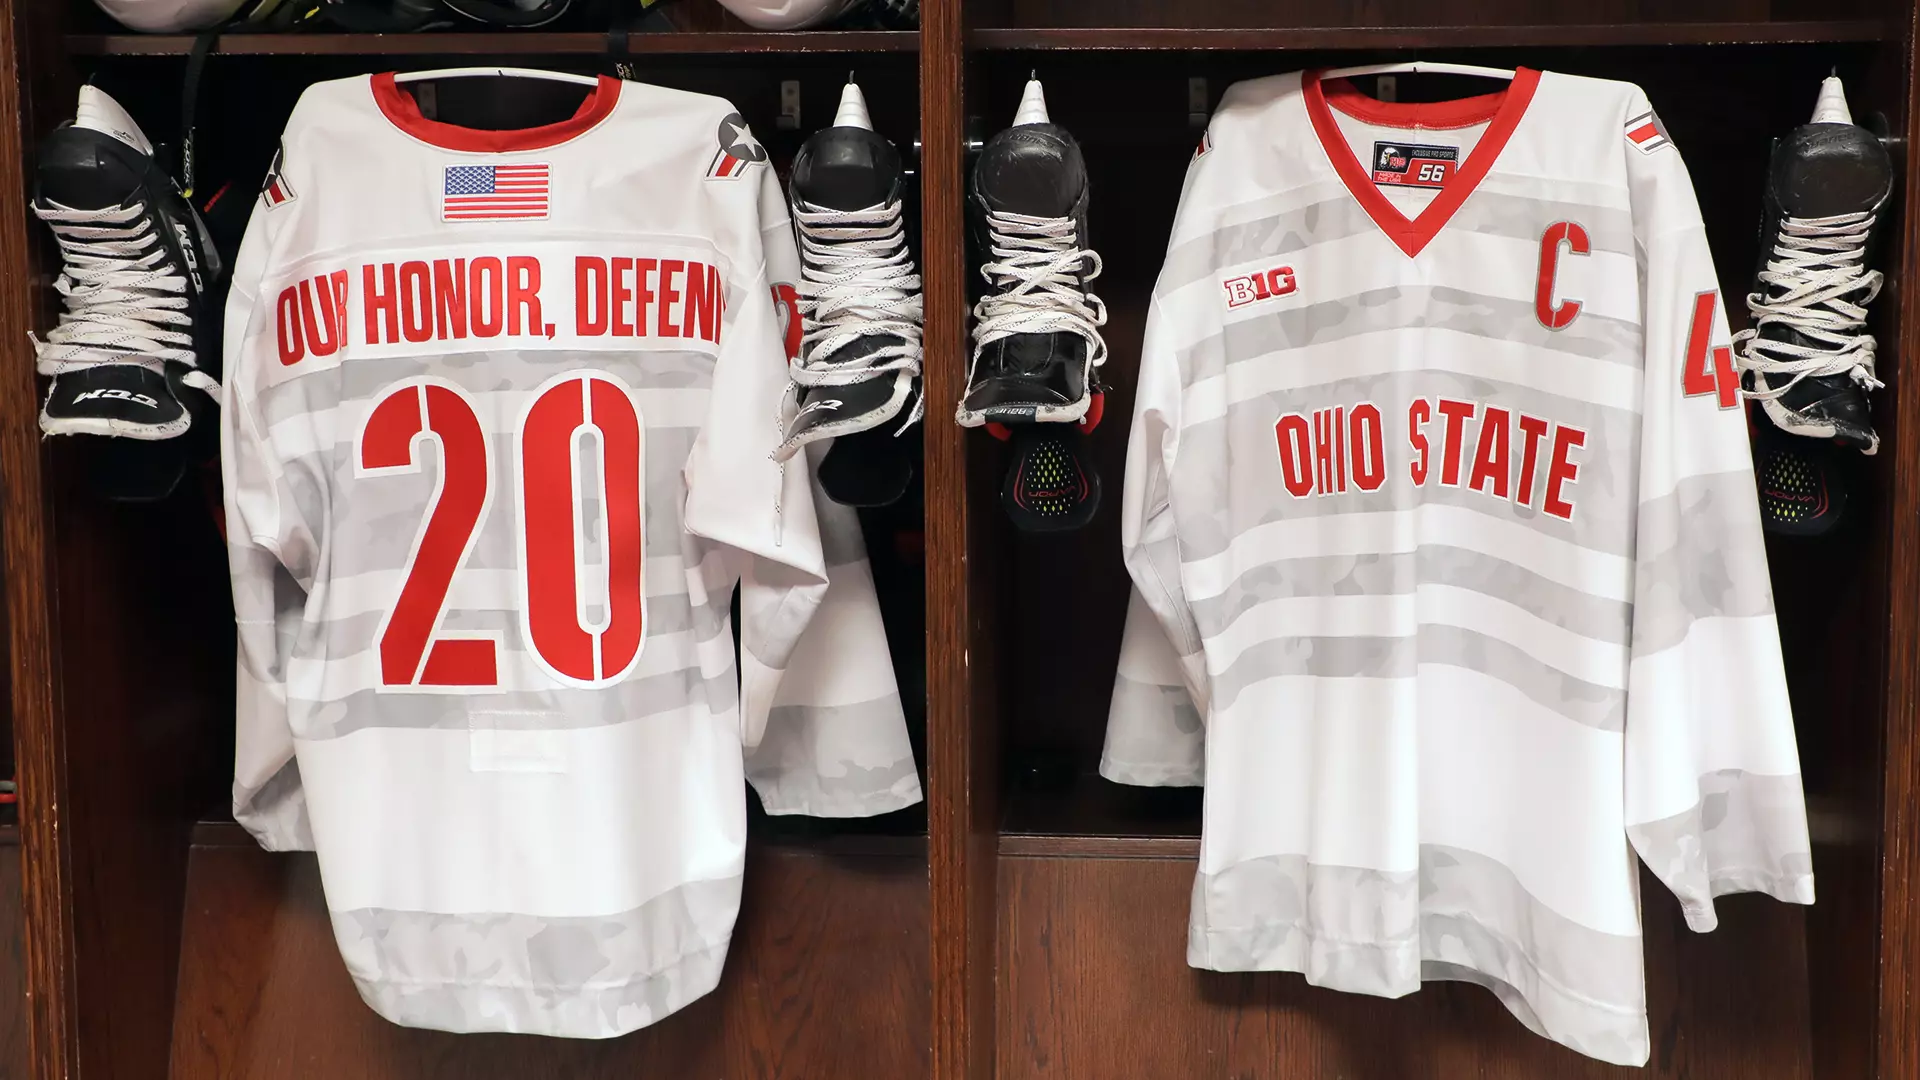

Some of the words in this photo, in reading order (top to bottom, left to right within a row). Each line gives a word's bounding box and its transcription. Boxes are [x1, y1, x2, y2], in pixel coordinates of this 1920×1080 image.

[1418, 163, 1446, 182] 56
[174, 224, 203, 295] CCM
[276, 268, 348, 367] OUR
[362, 255, 556, 345] HONOR,
[575, 255, 727, 346] DEFEN
[1533, 220, 1592, 332] C
[72, 388, 158, 409] CCM
[1681, 288, 1740, 410] 4
[1273, 400, 1388, 499] OHIO
[1407, 395, 1589, 523] STATE
[356, 373, 645, 691] 20
